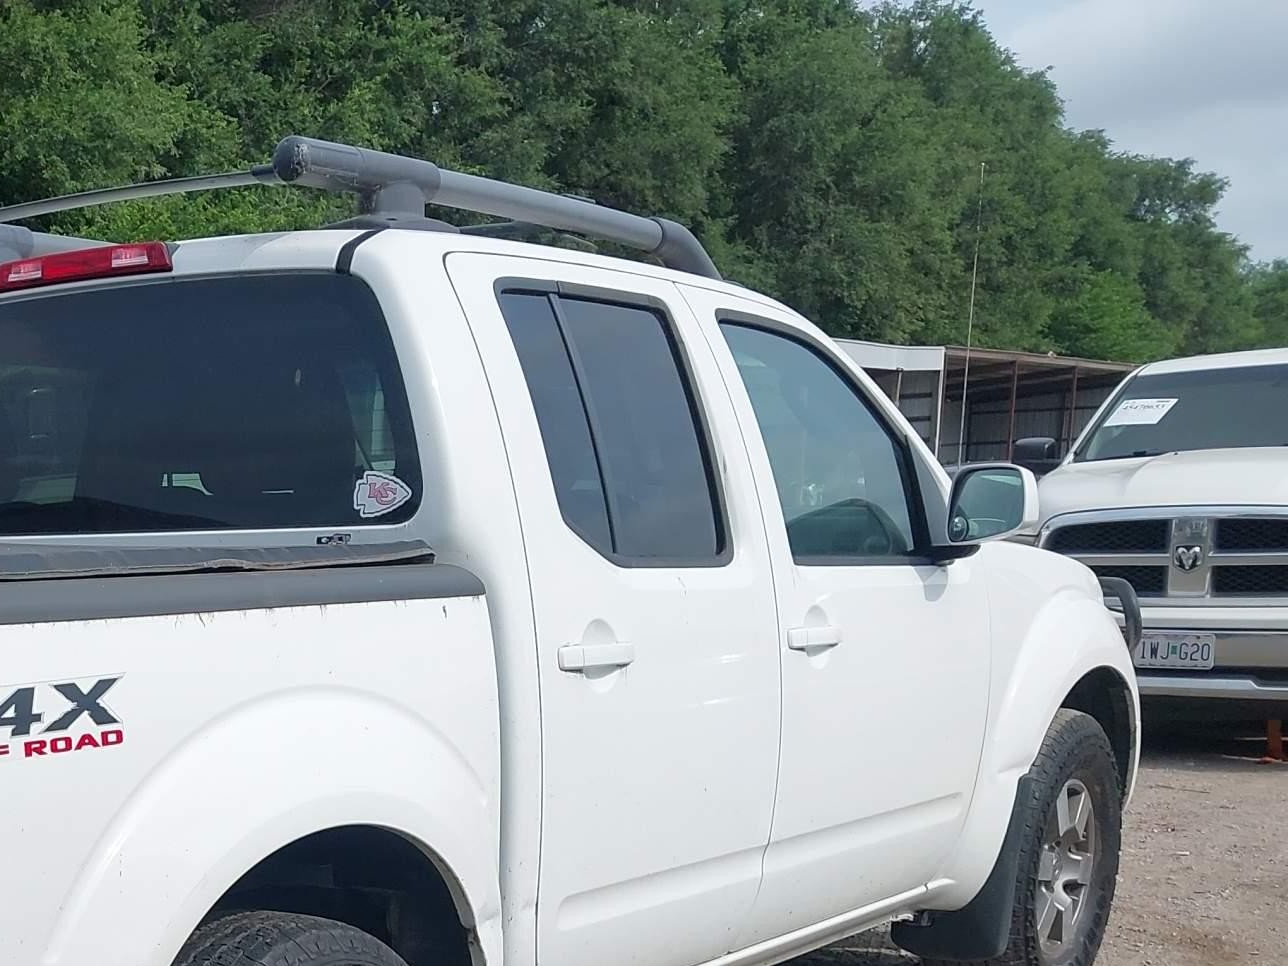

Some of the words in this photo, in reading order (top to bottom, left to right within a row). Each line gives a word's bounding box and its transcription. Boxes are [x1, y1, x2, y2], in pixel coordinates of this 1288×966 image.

[367, 481, 398, 506] KC
[1178, 642, 1212, 662] G20
[23, 729, 124, 758] ROAD
